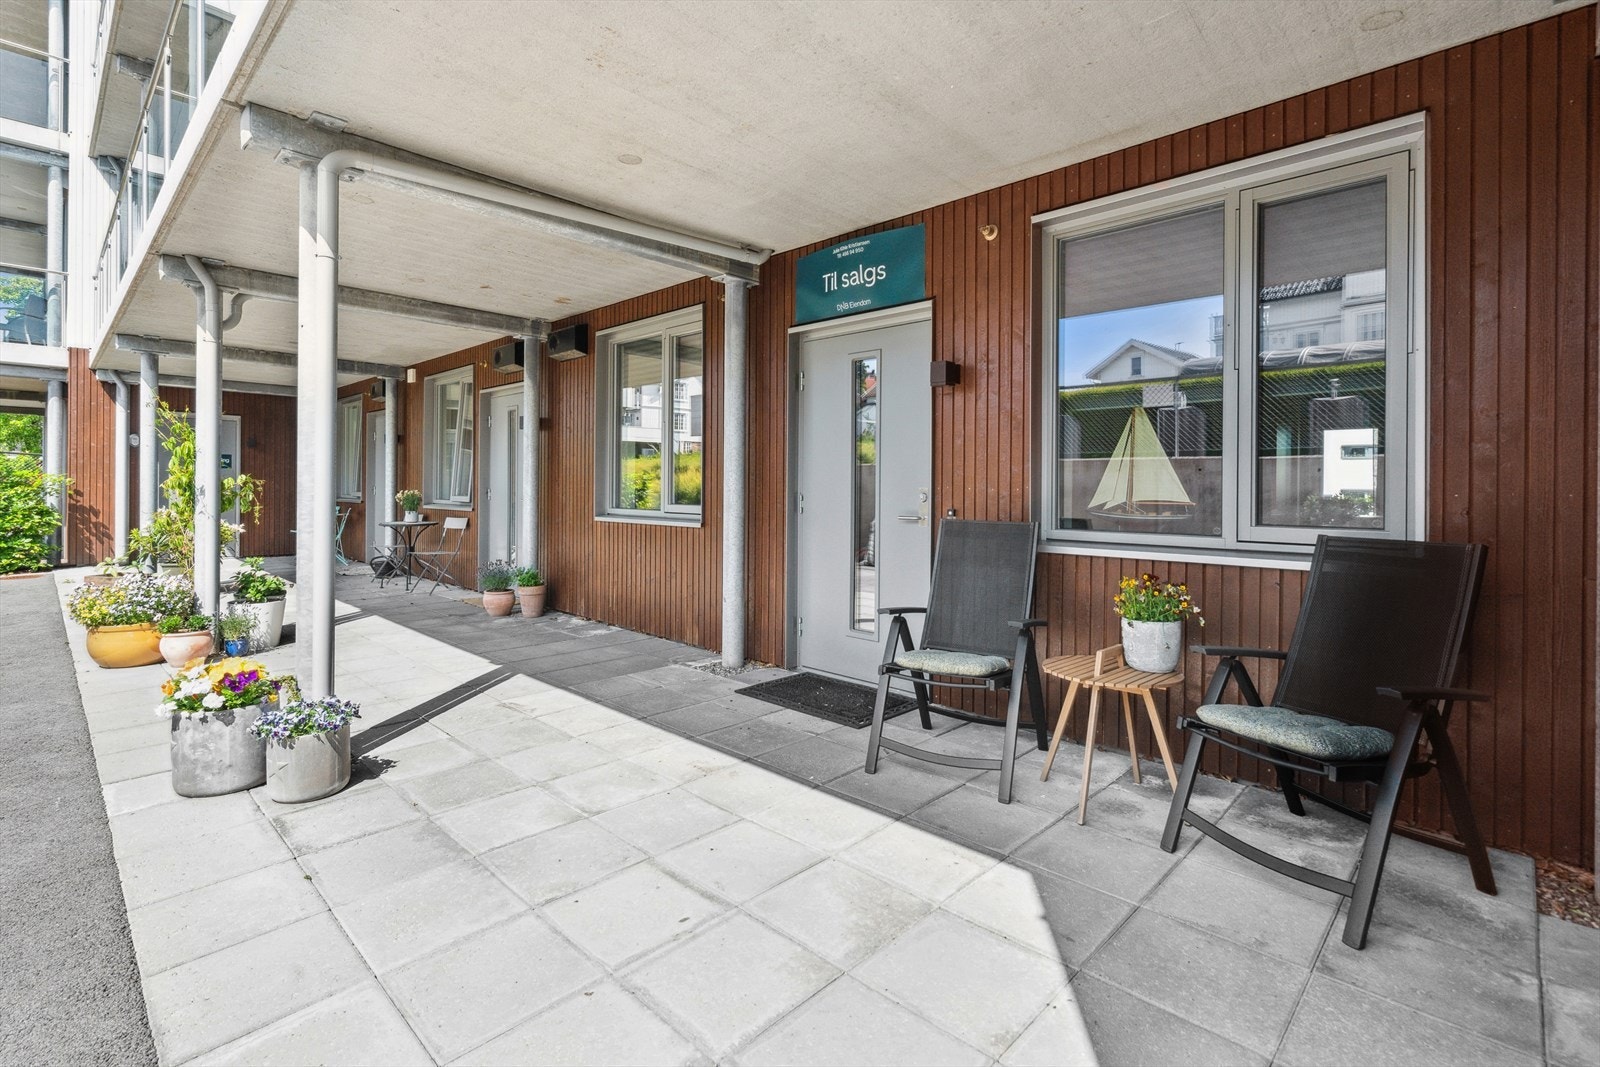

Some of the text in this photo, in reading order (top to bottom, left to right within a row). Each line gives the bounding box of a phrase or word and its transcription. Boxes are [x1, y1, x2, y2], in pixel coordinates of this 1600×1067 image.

[822, 264, 886, 293] Til salgs
[836, 299, 872, 313] DNB Eiendom
